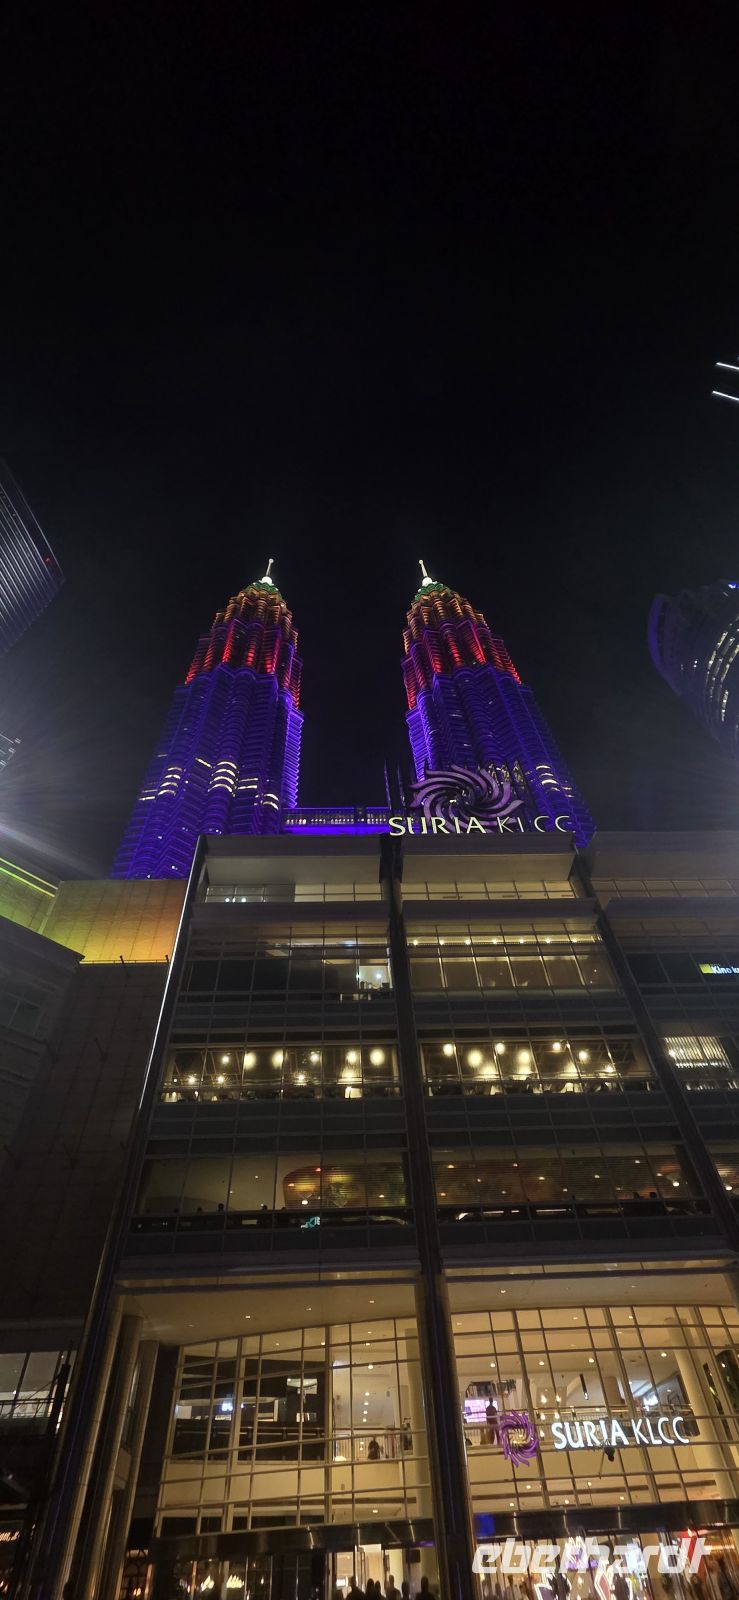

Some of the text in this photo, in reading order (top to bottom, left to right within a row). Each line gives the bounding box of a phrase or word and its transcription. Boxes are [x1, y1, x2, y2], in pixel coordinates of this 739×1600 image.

[388, 816, 486, 836] SURIA
[551, 1416, 690, 1449] SURIA KLCC
